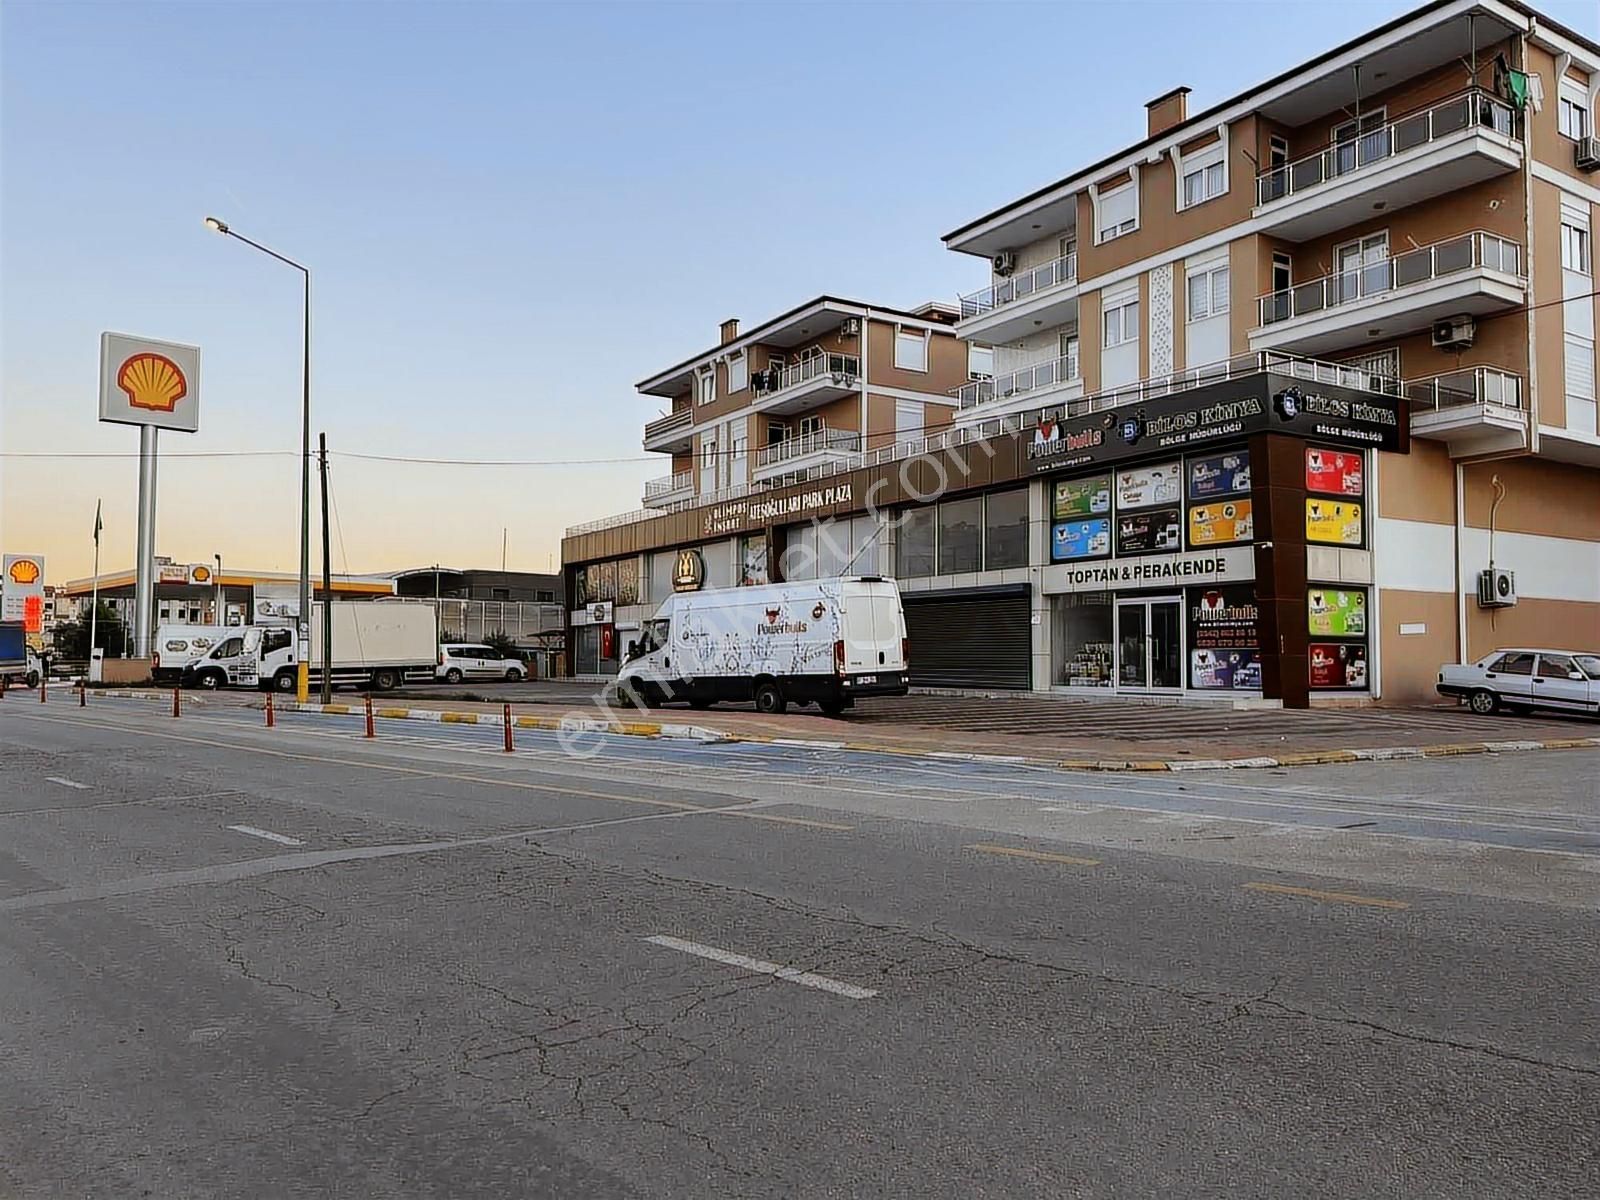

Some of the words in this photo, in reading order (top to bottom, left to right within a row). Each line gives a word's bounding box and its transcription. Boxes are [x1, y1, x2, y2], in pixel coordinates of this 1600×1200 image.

[1146, 412, 1197, 437] BİLOS
[1201, 399, 1262, 425] KİMYA
[802, 489, 824, 511] PARK
[825, 484, 852, 506] PLAZA
[1067, 567, 1119, 584] TOPTAN
[1122, 566, 1131, 580] &
[1133, 558, 1226, 579] PERAKENDE
